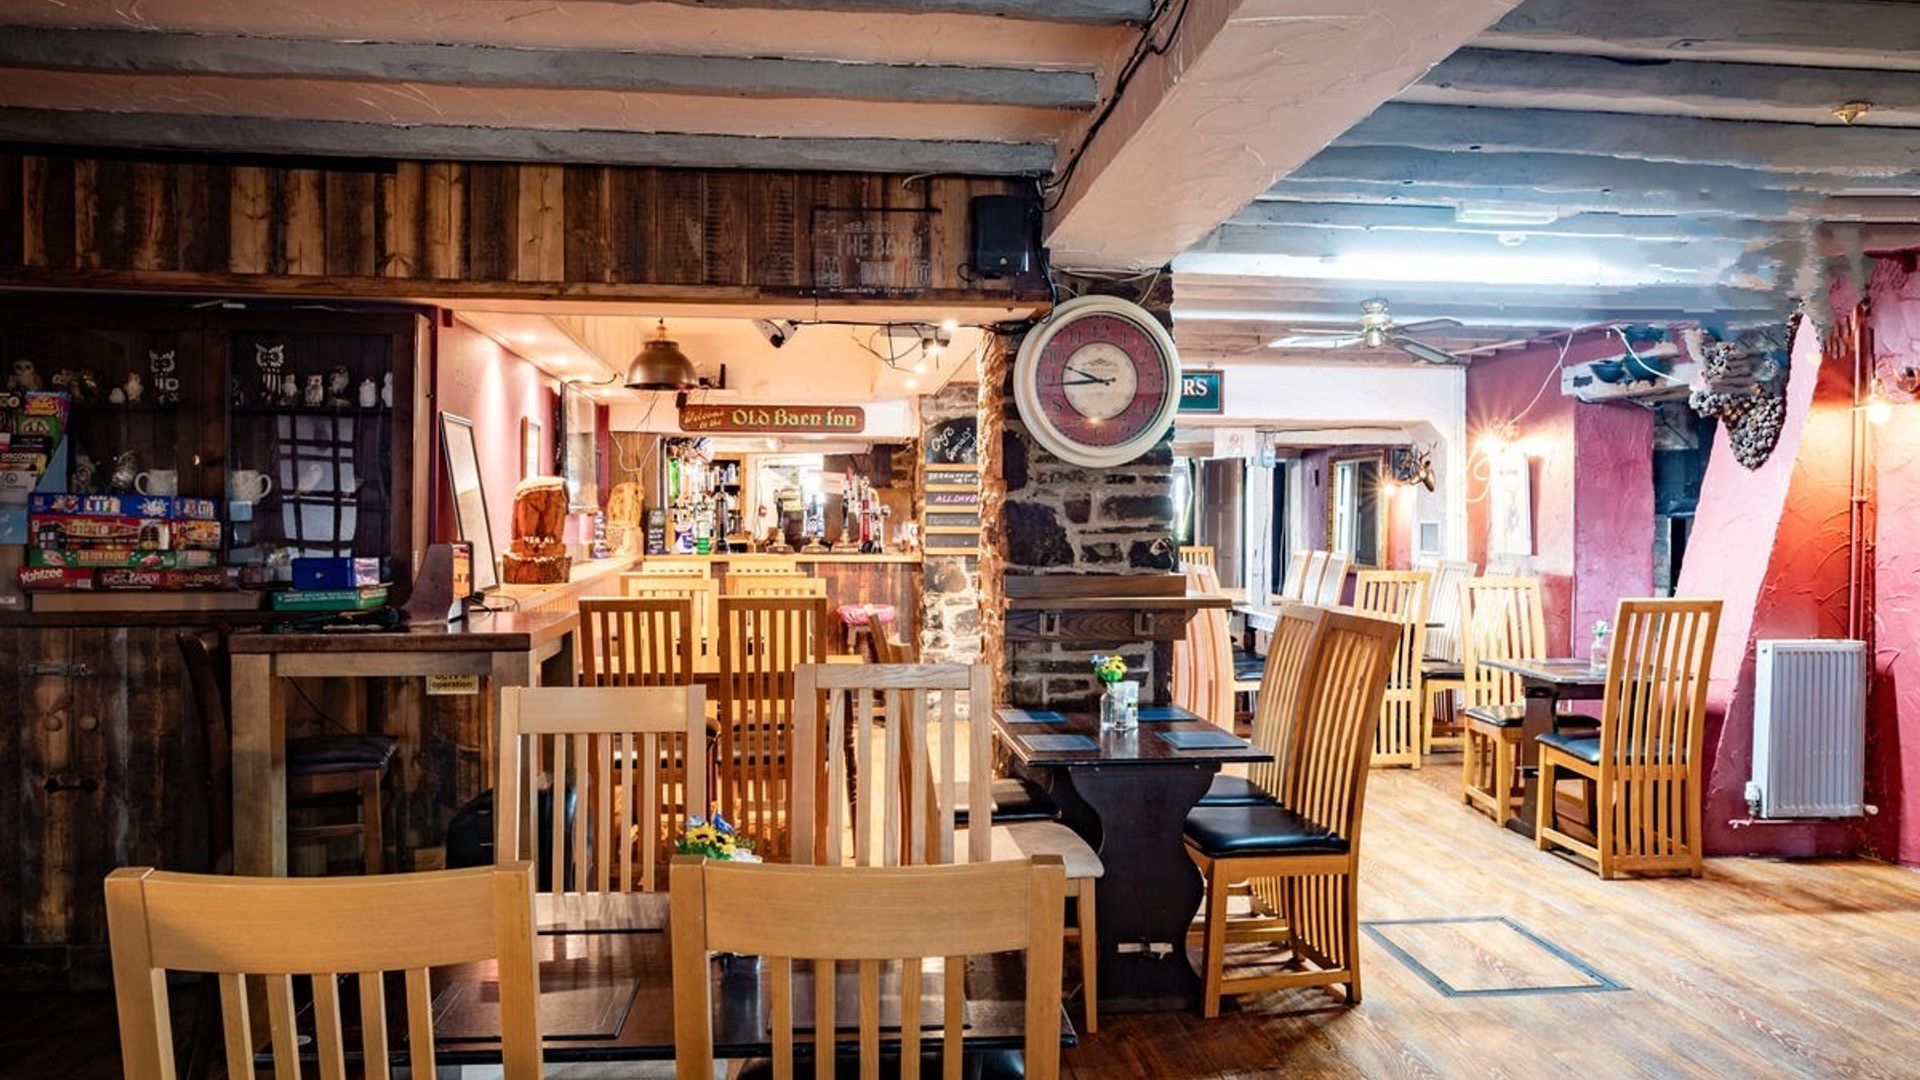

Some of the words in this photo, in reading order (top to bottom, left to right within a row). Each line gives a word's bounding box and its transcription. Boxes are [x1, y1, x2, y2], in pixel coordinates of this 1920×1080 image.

[1183, 378, 1209, 396] RS
[85, 500, 121, 514] LIFE
[20, 568, 64, 584] Yahtzee
[432, 680, 473, 689] operation
